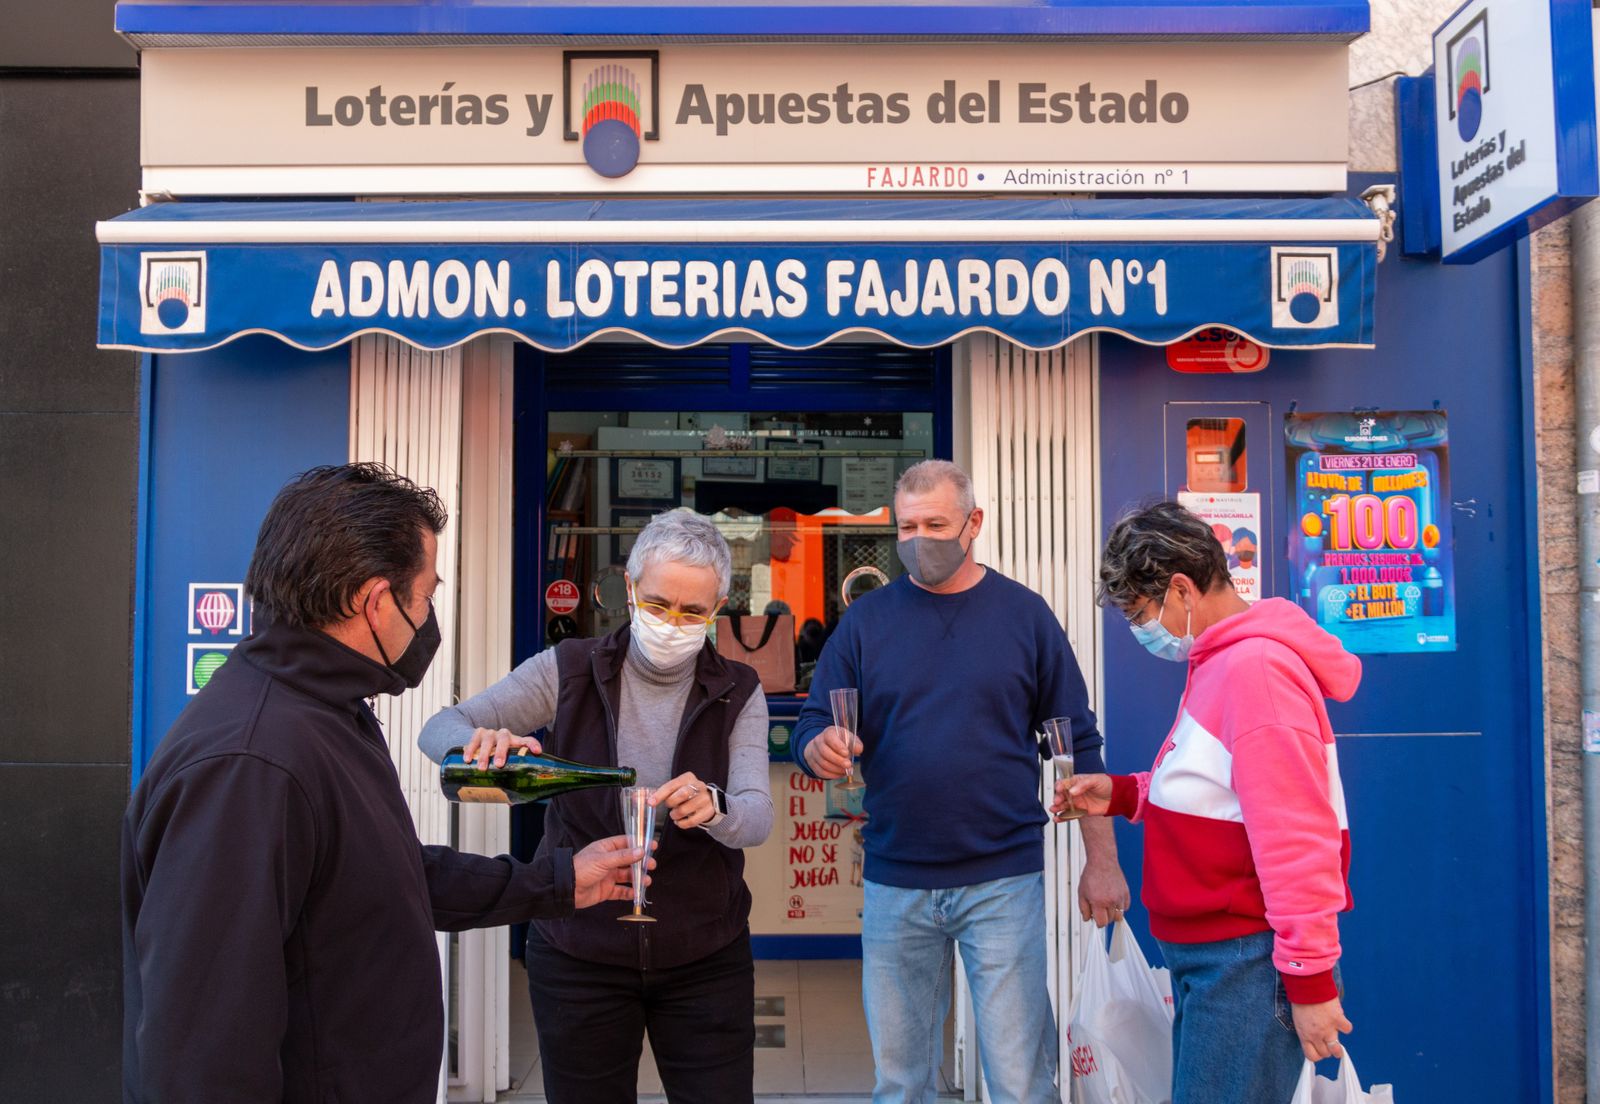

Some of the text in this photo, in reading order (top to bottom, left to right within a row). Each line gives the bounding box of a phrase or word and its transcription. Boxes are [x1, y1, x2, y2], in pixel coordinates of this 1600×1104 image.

[305, 80, 1190, 136] Loterías y Apuestas del Estado
[1451, 129, 1507, 180] Loterías y
[867, 166, 969, 189] FAJARDO
[1004, 167, 1146, 188] Administración
[1182, 169, 1190, 187] 1
[1453, 139, 1526, 206] Apuestas del
[1453, 195, 1491, 233] Estado
[310, 259, 527, 318] ADMON.
[546, 259, 808, 319] LOTERIAS
[826, 258, 1070, 317] FAJARDO
[1325, 455, 1413, 468] VIERNES 21 DE ENERO
[1347, 476, 1362, 491] DE
[1373, 471, 1427, 492] MILLONES
[1323, 494, 1417, 550] 100
[1324, 553, 1368, 566] PREMIOS
[1369, 553, 1410, 566] SEGUROS
[553, 584, 572, 595] +18
[1371, 584, 1397, 600] BOTE
[790, 772, 824, 792] CON
[790, 796, 807, 817] EL
[790, 821, 841, 841] JUEGO
[790, 844, 839, 864] NO SE
[790, 867, 839, 889] JUEGA
